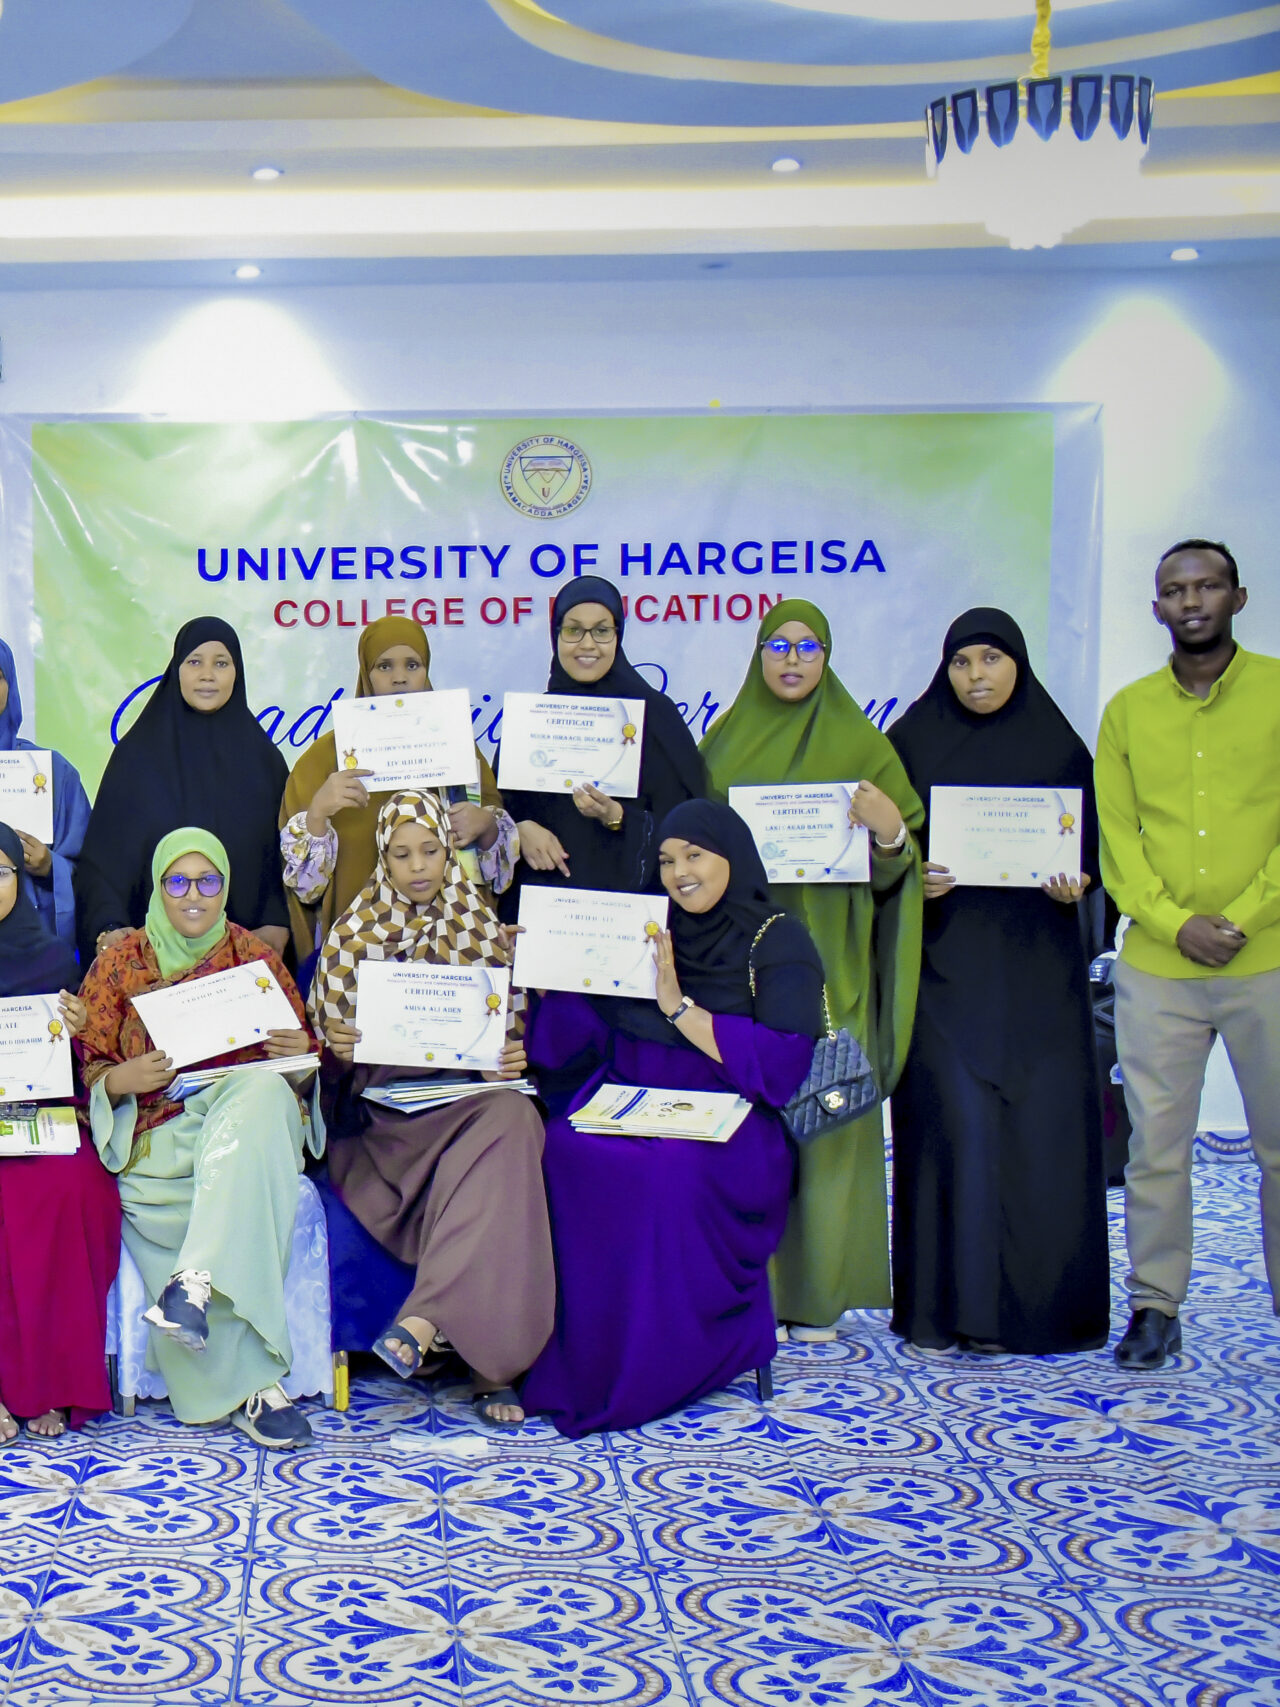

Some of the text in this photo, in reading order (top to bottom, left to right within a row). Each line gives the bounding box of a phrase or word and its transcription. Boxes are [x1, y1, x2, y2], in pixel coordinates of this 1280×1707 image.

[504, 438, 540, 474] UNIVERSITY
[557, 439, 588, 473] HARGEISA
[503, 479, 589, 517] JAAMACADDA HARGEYSA
[197, 539, 887, 582] UNIVERSITY OF HARGEISA
[273, 597, 465, 628] COLLEGE
[479, 596, 533, 626] OF
